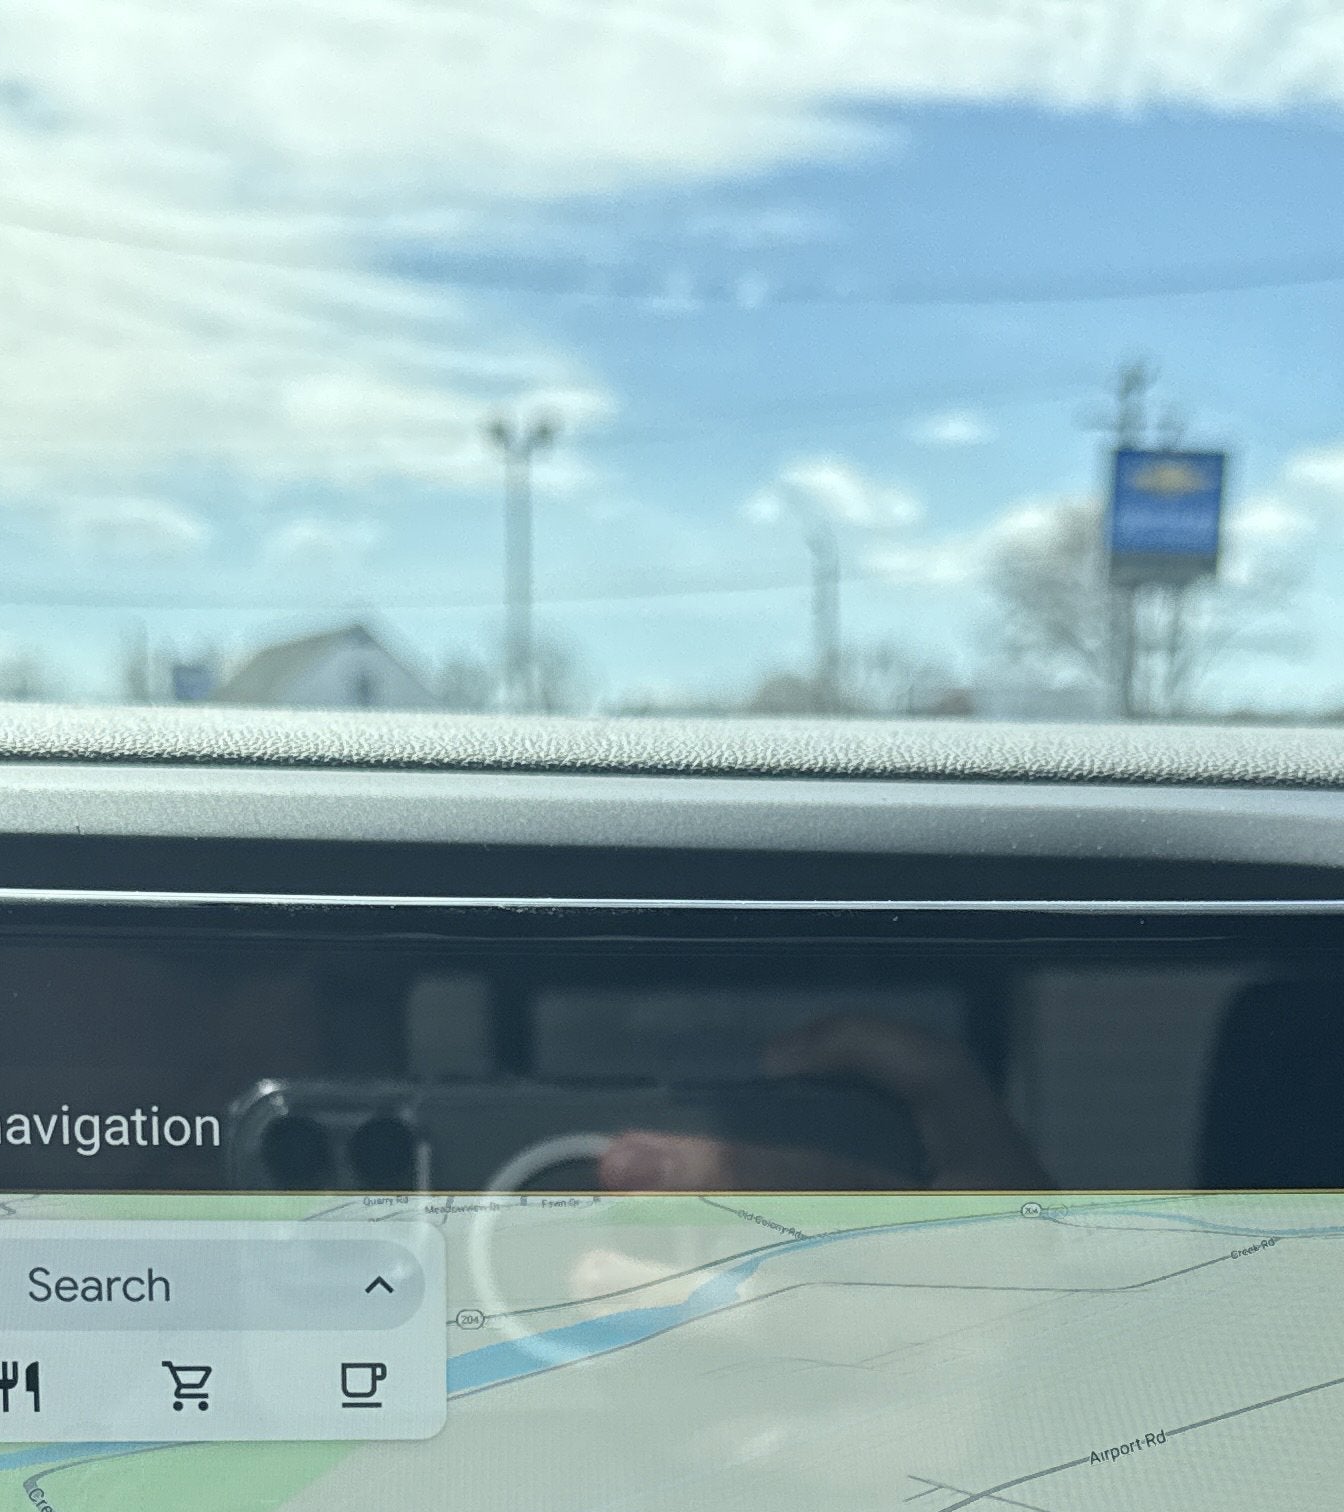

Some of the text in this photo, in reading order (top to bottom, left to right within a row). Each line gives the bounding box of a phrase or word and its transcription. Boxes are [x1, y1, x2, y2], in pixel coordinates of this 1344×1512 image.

[1261, 1237, 1276, 1250] Rd
[27, 1266, 171, 1303] Search
[460, 1314, 480, 1325] 204
[1089, 1429, 1167, 1465] Airport Rd
